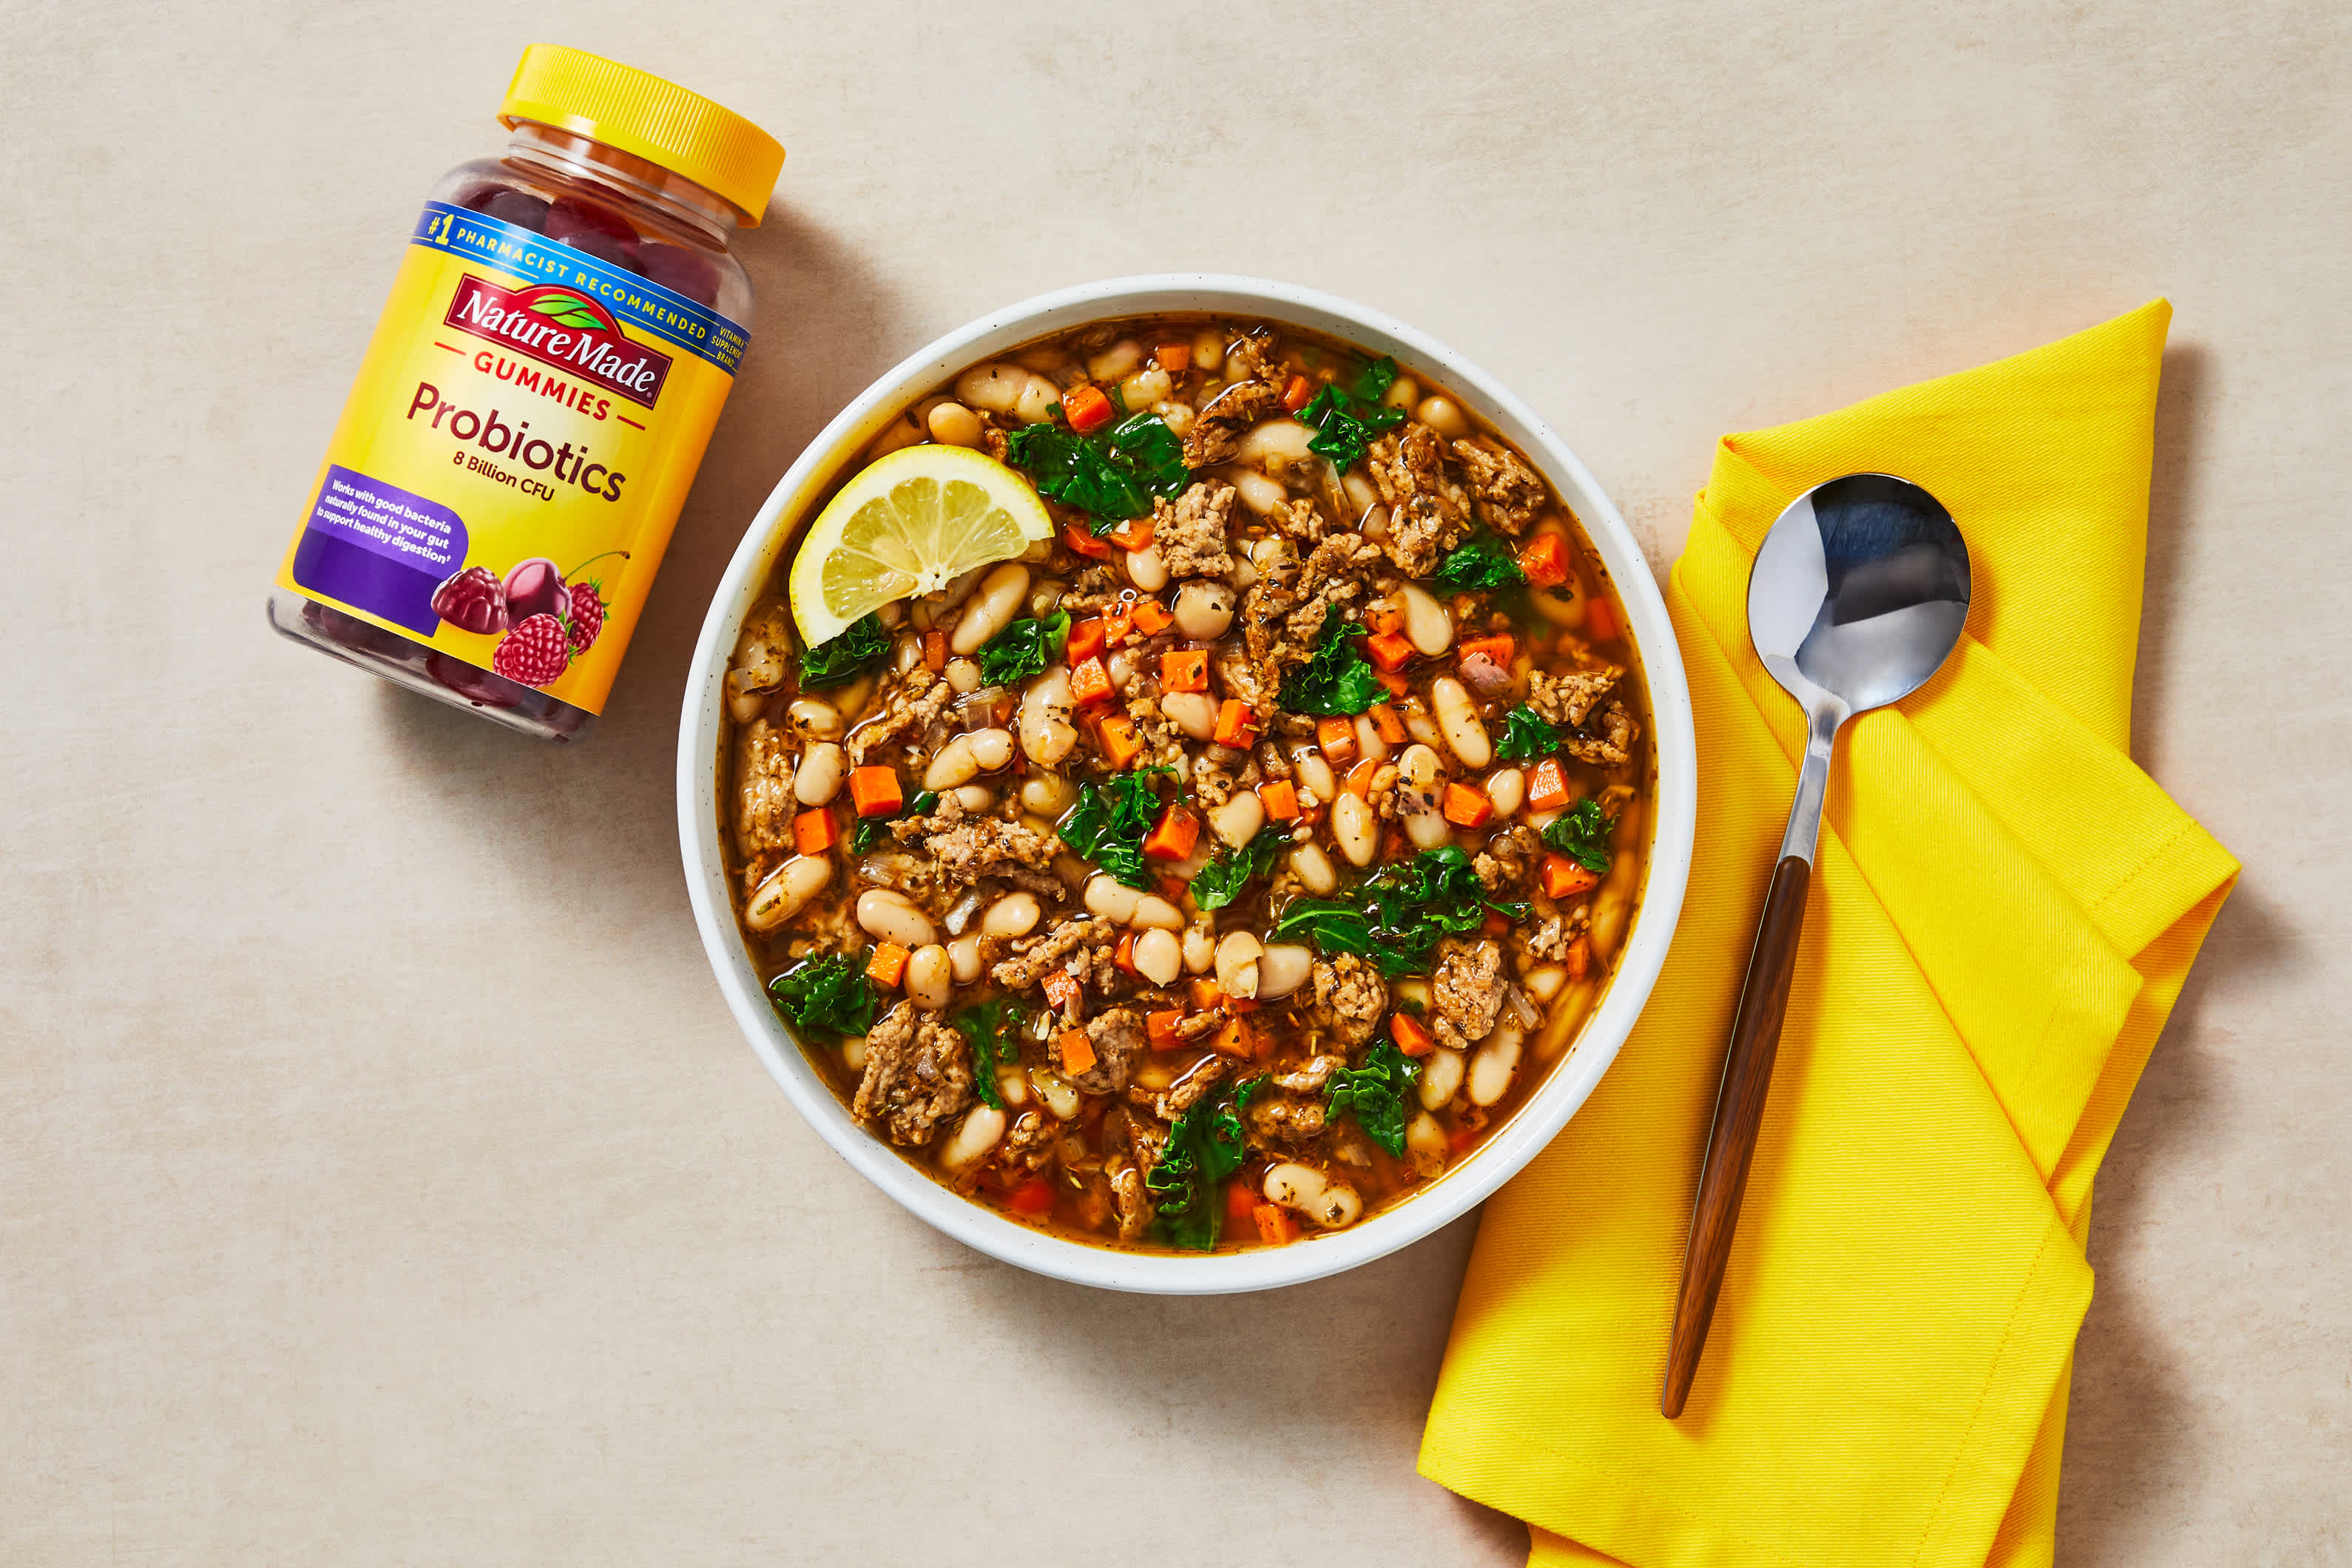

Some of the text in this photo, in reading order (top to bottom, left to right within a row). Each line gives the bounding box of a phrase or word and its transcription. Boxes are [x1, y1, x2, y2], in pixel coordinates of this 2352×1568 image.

[428, 214, 706, 339] #1 PHARMACIST RECOMMENDED
[456, 290, 655, 393] Nature Made
[720, 326, 742, 345] VITAMIN
[474, 351, 611, 421] GUMMIES
[407, 381, 626, 502] Probiotics
[453, 451, 555, 501] 8 Billion CFU
[317, 507, 323, 517] to
[323, 511, 354, 529] support
[354, 520, 392, 544] healthy
[325, 494, 450, 550] naturally found in your gut
[331, 479, 451, 534] Works with good bacteria
